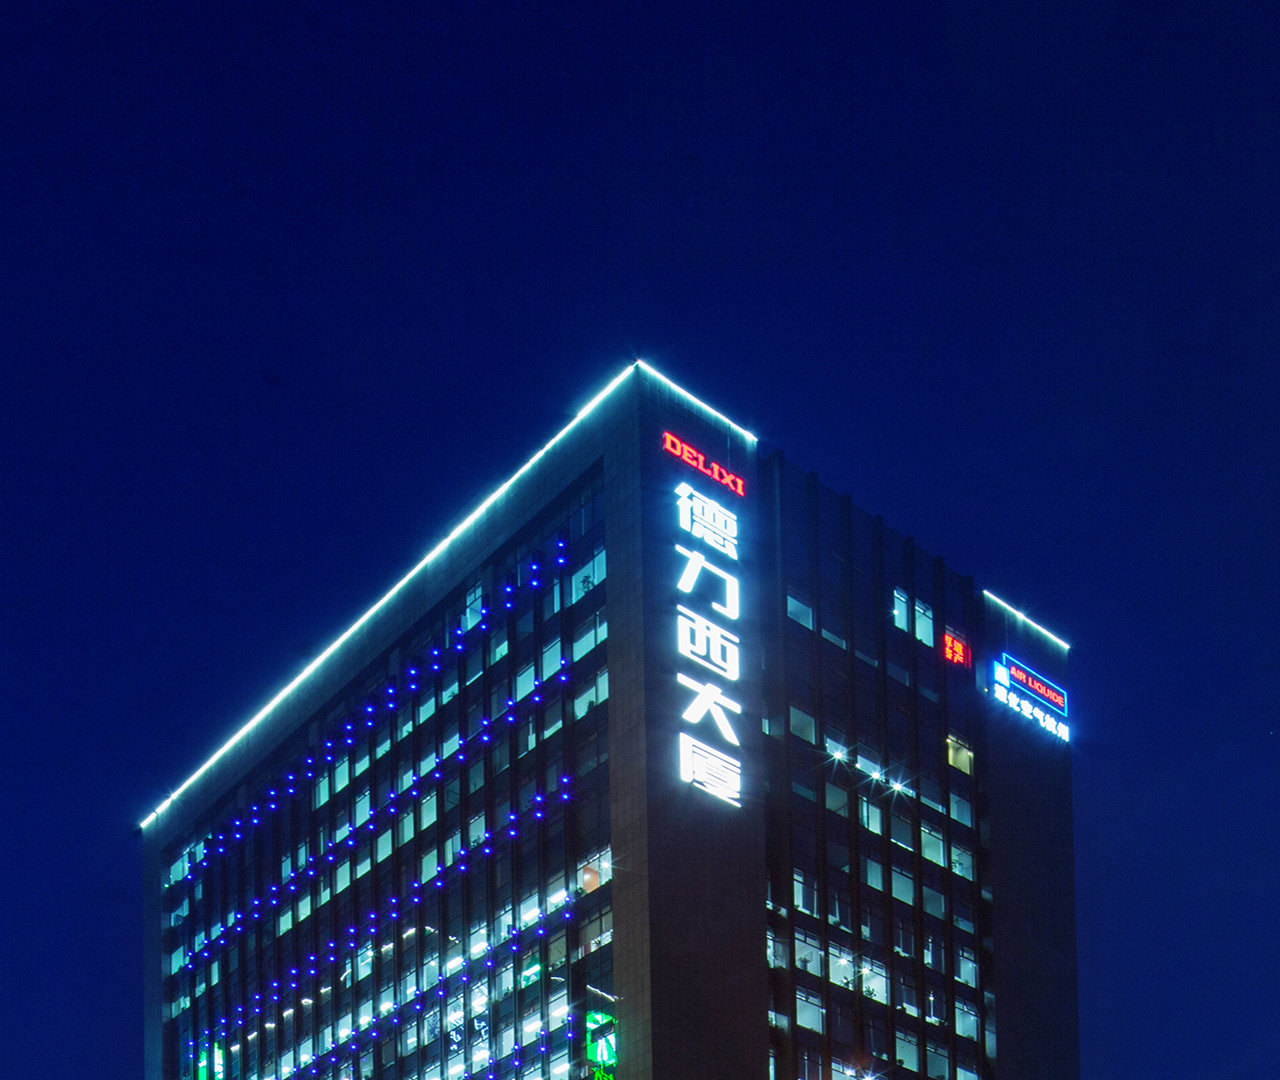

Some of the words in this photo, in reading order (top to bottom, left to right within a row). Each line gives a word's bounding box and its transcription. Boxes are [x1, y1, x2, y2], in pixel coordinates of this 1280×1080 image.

[662, 431, 745, 497] DELIXI
[674, 481, 742, 809] 德力西大厦
[1010, 666, 1026, 683] AIR
[1028, 676, 1064, 707] LIQUIDE
